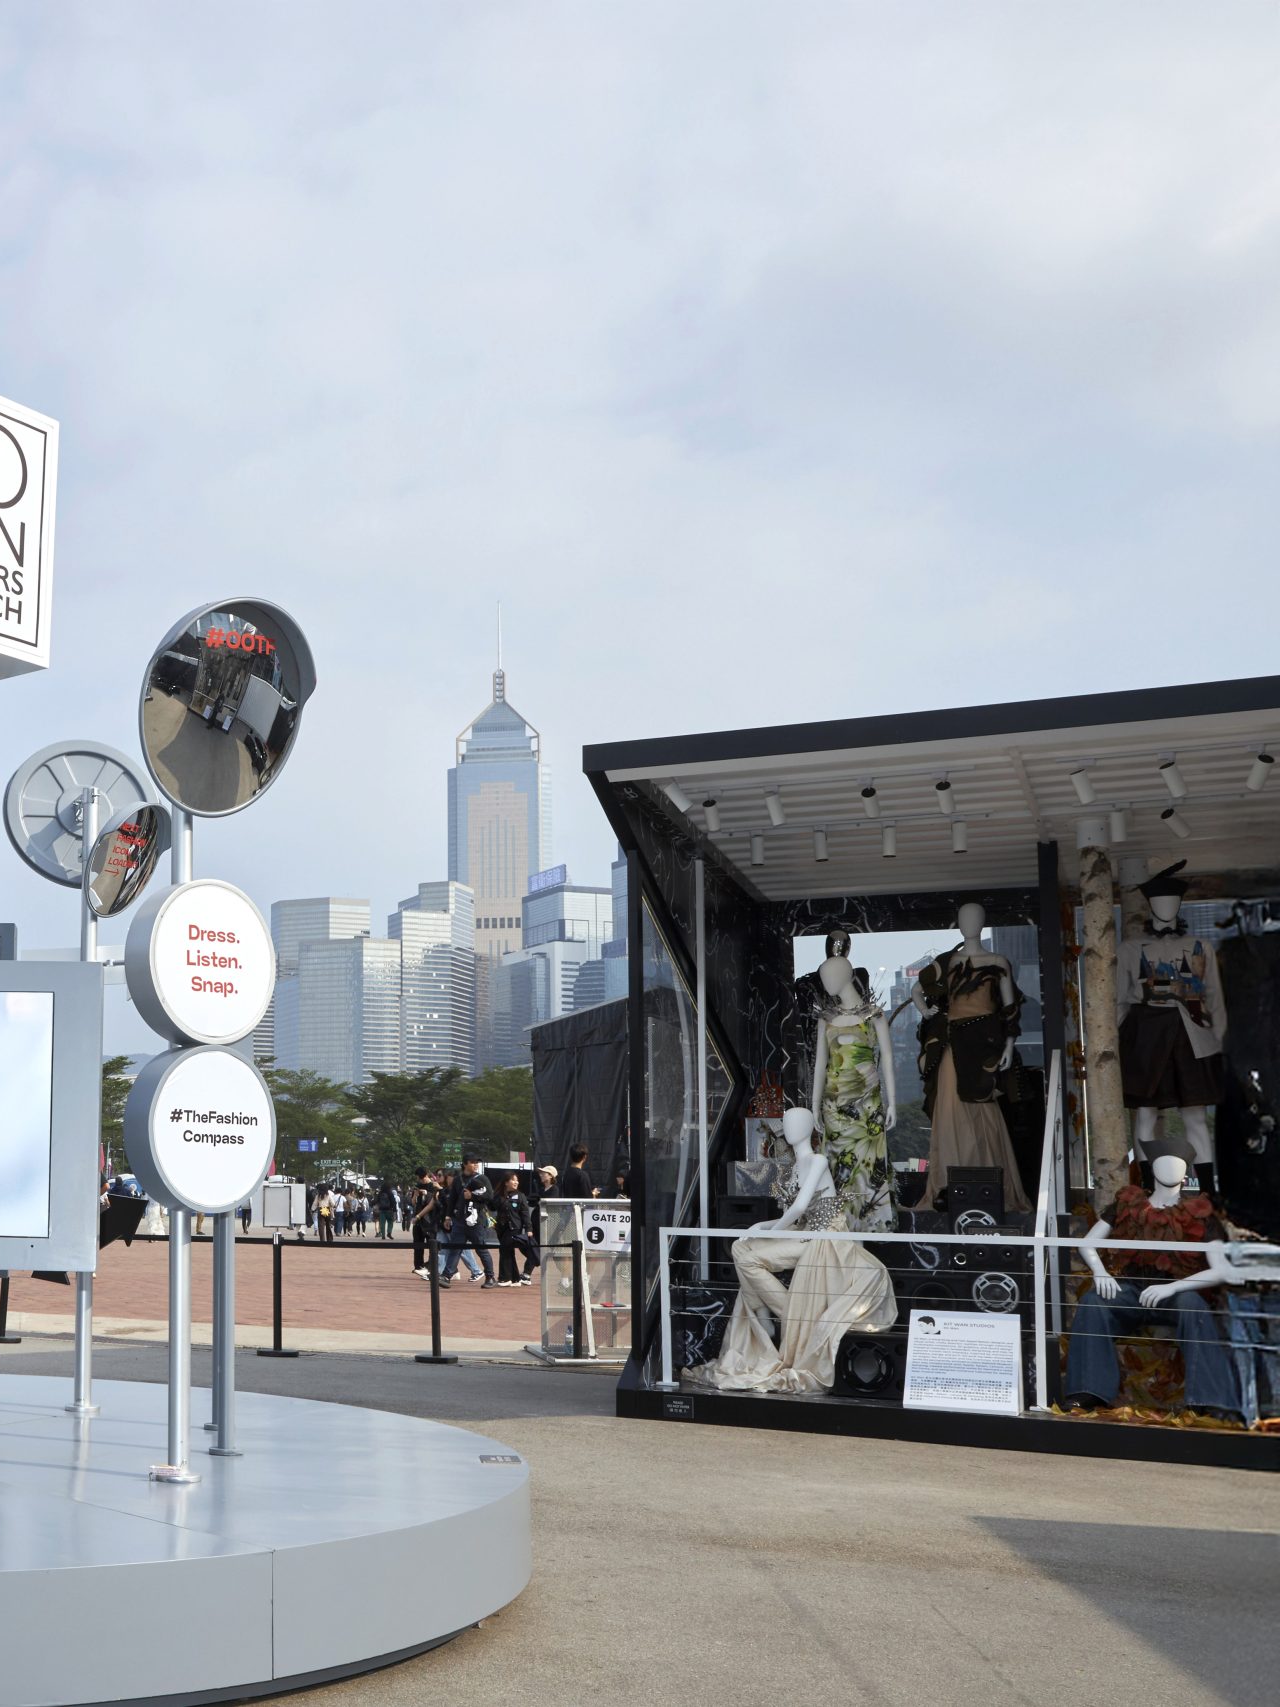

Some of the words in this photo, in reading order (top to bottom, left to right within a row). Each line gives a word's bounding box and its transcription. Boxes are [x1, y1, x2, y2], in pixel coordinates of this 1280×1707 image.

[188, 924, 240, 944] Dress.
[186, 950, 242, 970] Listen.
[191, 976, 238, 998] Snap.
[170, 1108, 258, 1126] #TheFashion
[182, 1130, 245, 1147] Compass
[592, 1213, 617, 1223] GATE
[591, 1230, 599, 1240] E
